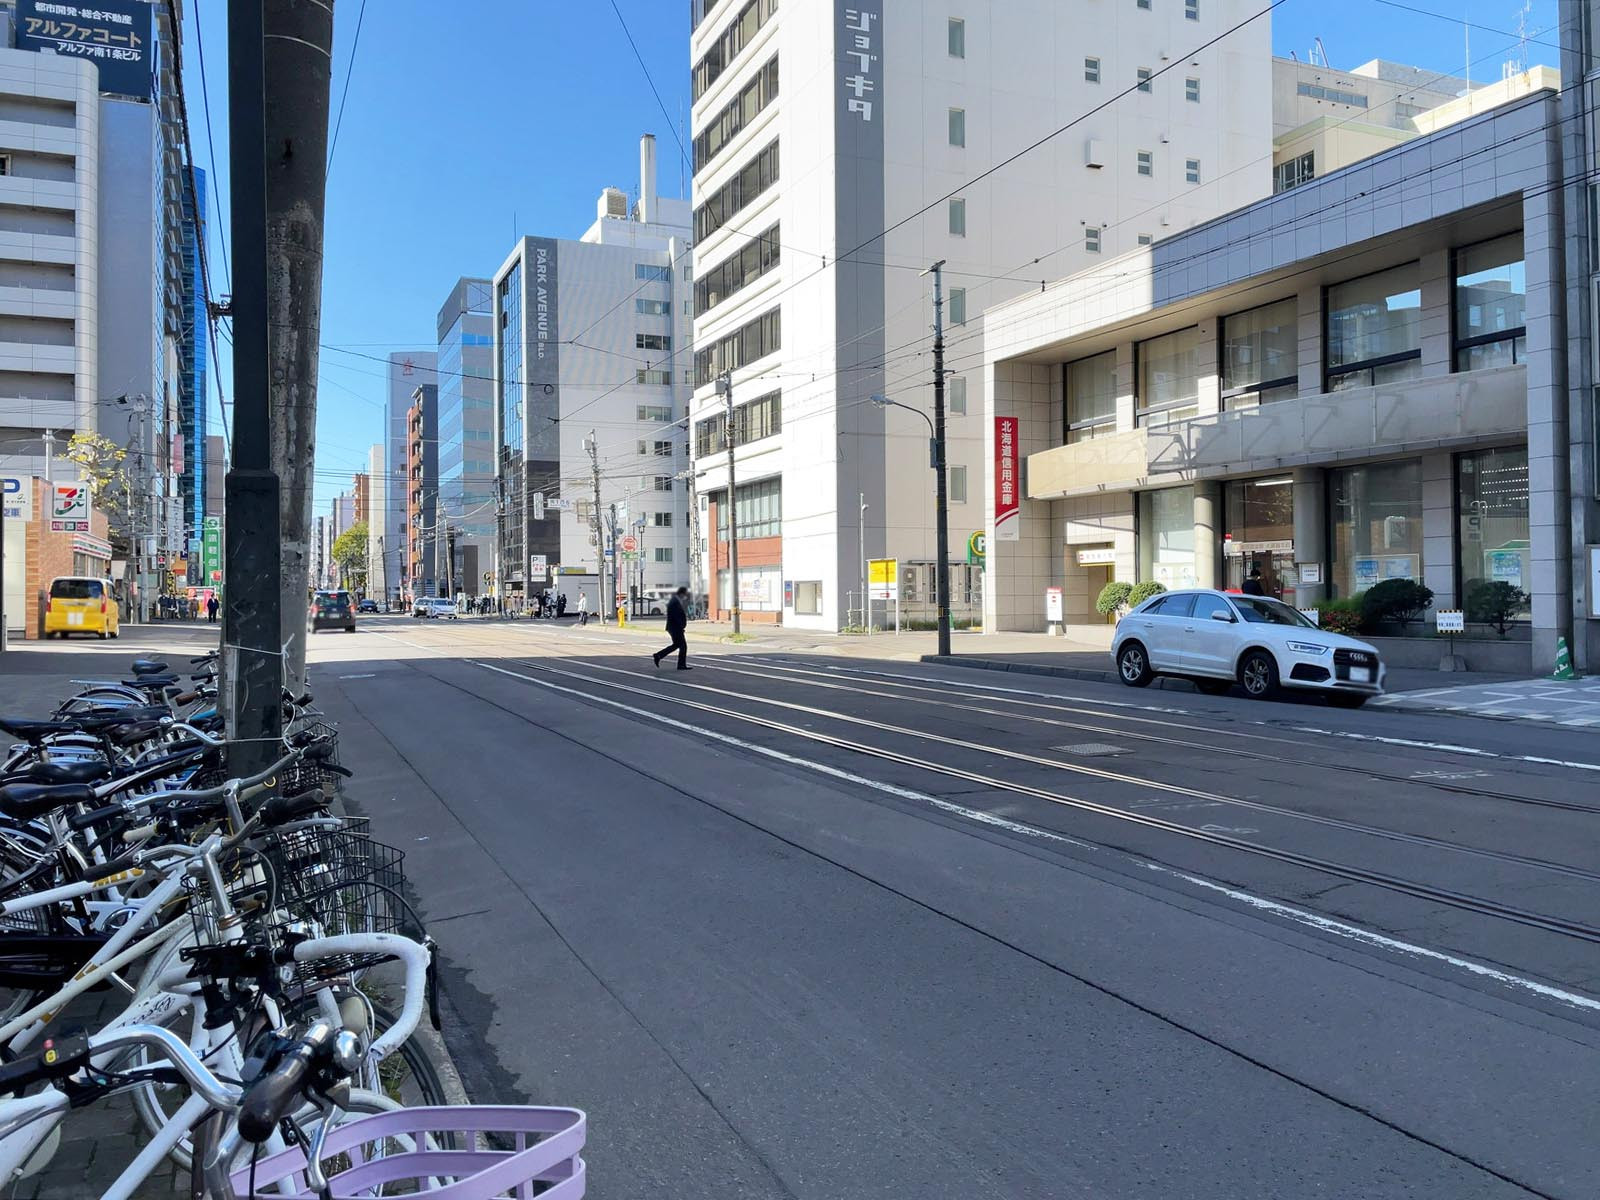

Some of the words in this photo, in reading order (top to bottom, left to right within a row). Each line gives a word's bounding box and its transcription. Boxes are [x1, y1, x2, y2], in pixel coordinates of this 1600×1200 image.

[25, 17, 142, 48] アルファコート
[537, 248, 547, 282] PARK
[537, 286, 548, 340] AVENUE
[1001, 420, 1012, 505] 北海道信用金庫
